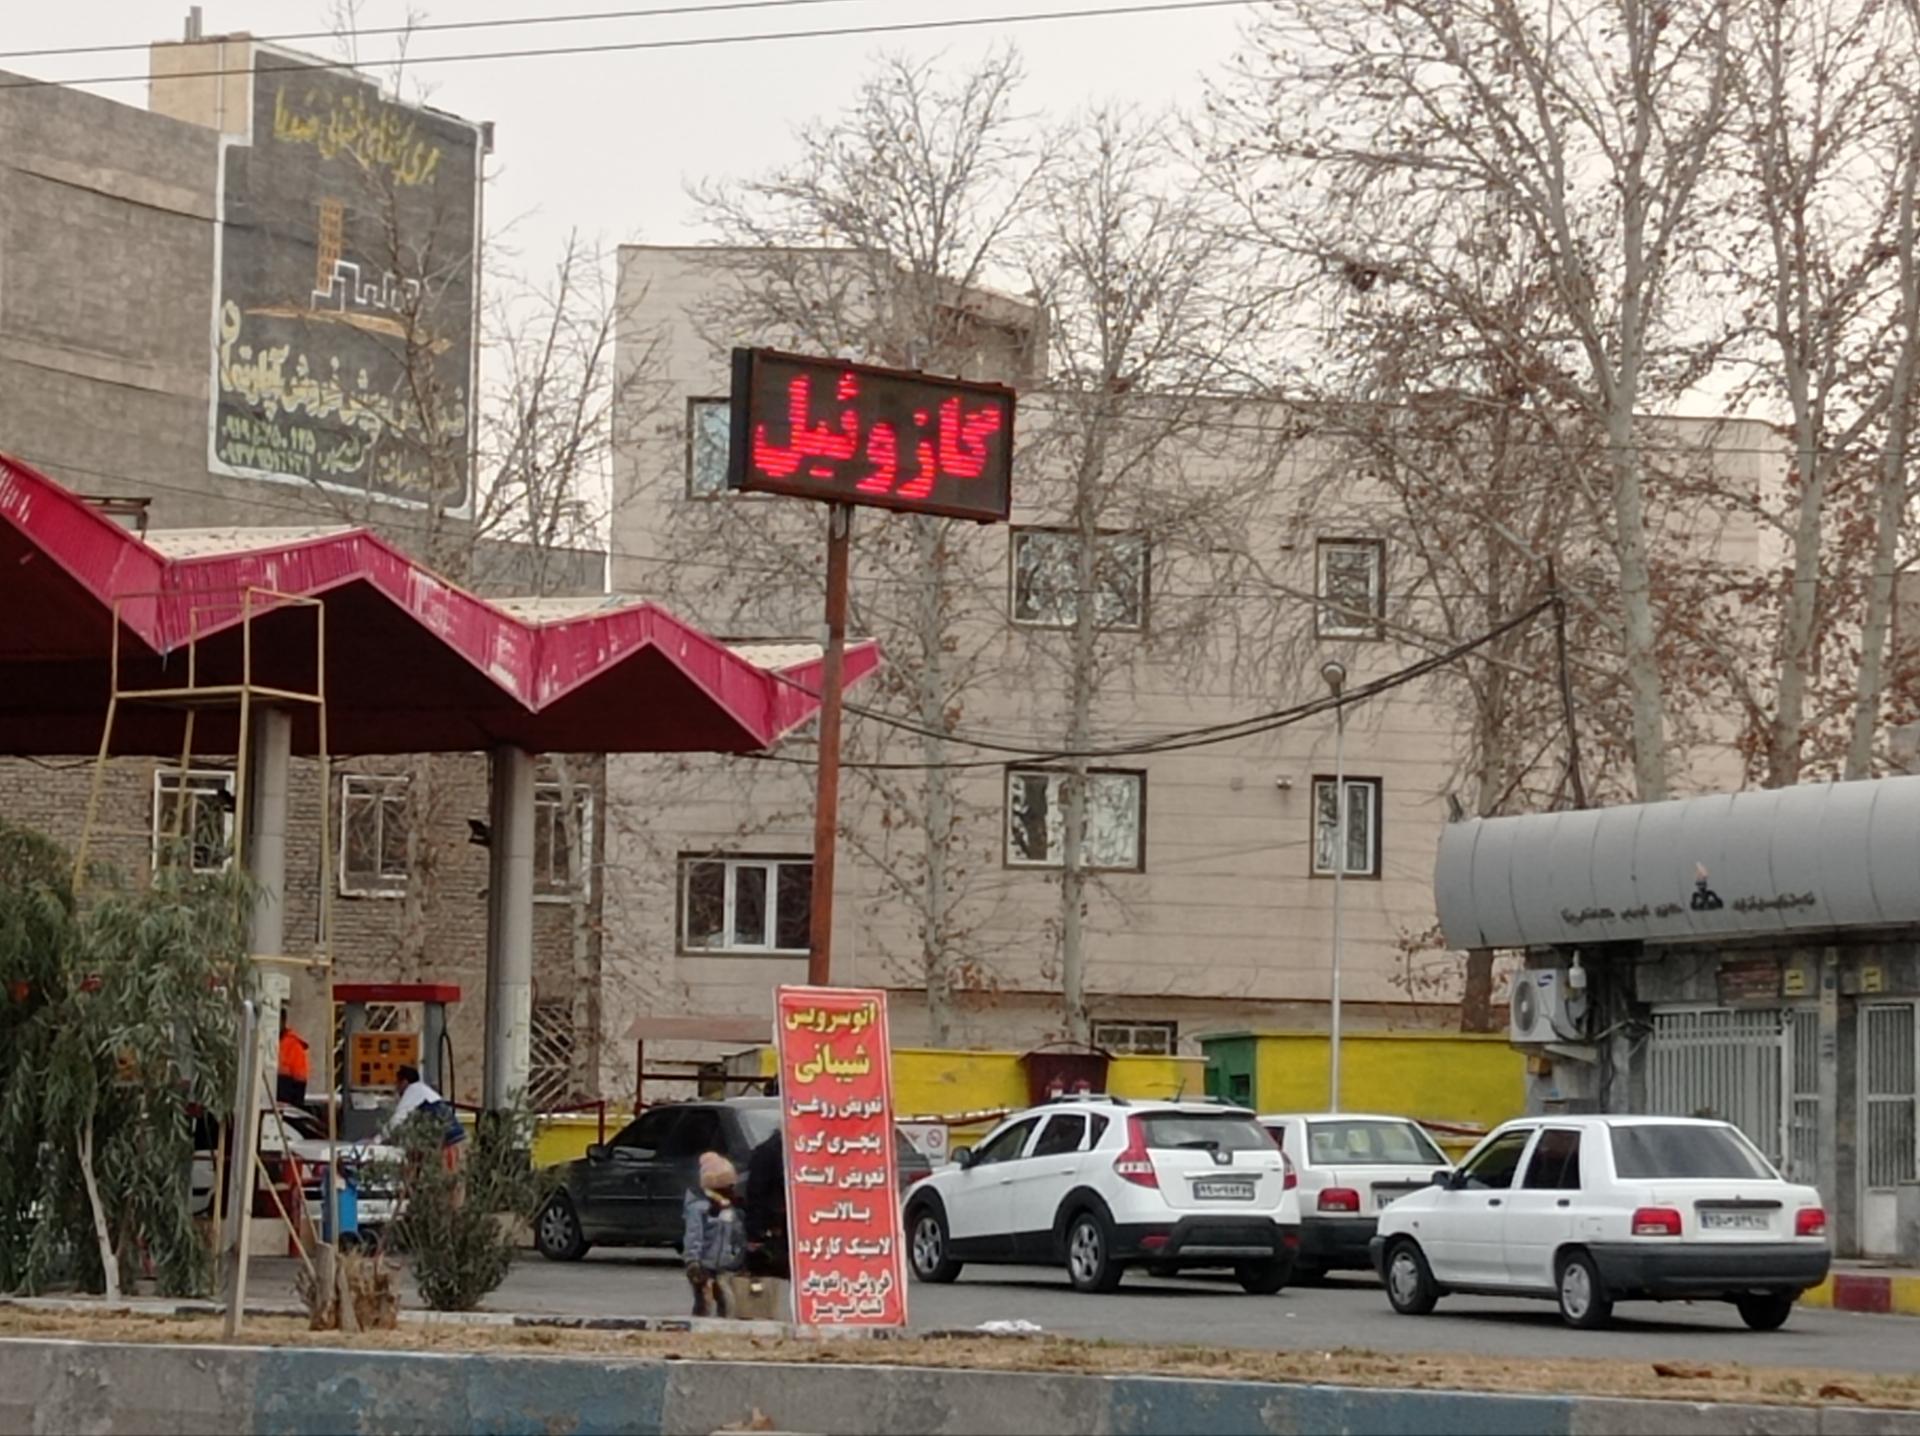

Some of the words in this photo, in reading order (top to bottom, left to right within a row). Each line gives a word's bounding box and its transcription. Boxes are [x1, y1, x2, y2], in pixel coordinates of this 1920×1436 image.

[784, 1001, 876, 1030] اتوسرویس
[795, 1043, 871, 1084] شیبانی
[790, 1095, 836, 1119] روغن
[838, 1094, 883, 1120] تعویض
[793, 1129, 826, 1153] گیری
[827, 1133, 882, 1156] پنچری
[838, 1166, 886, 1190] تعویض
[808, 1199, 871, 1225] بالانس
[844, 1236, 892, 1259] لاستیک
